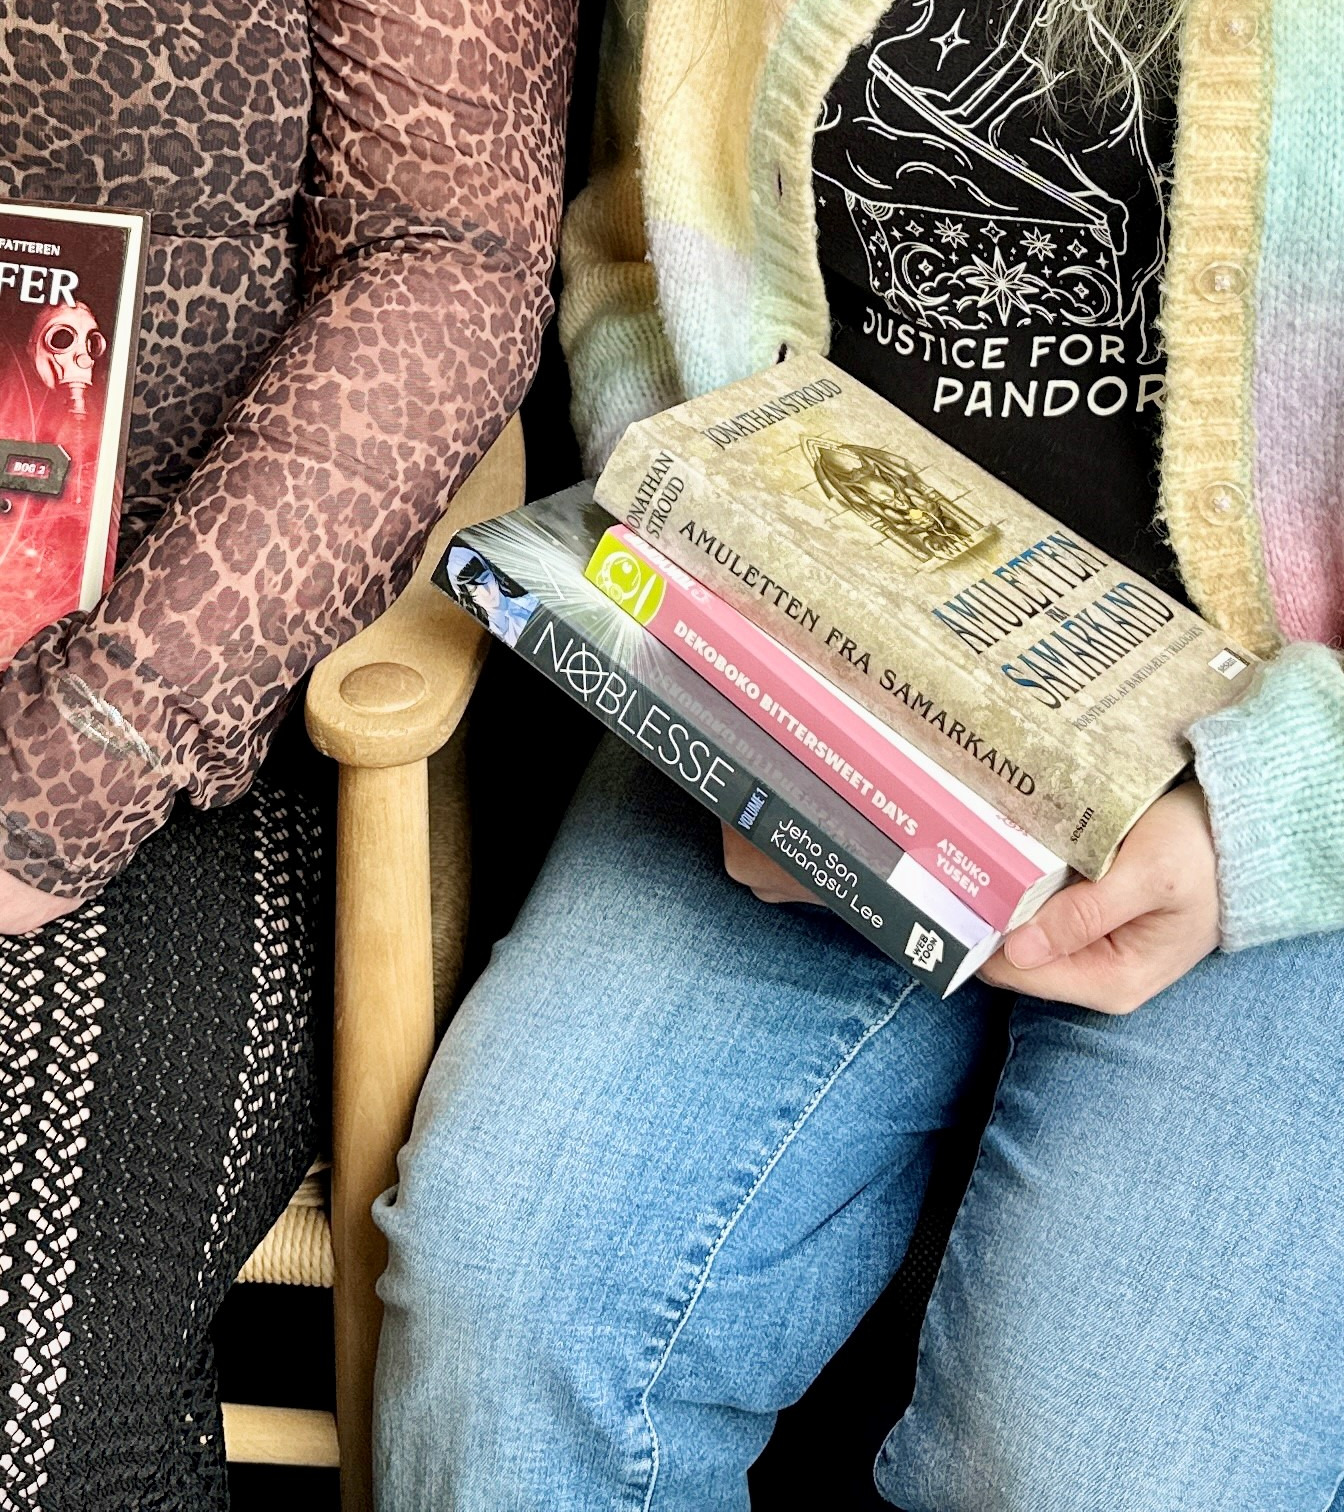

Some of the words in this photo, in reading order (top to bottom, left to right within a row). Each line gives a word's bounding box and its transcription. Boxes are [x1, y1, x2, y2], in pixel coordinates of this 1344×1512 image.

[863, 306, 1010, 370] JUSTICE
[1029, 334, 1126, 367] FOR
[700, 400, 790, 450] JONATHAN
[778, 378, 843, 415] STROUD
[13, 461, 36, 474] BOG
[37, 465, 46, 475] 2
[626, 448, 674, 530] ONATHAN
[646, 476, 685, 539] STROUD
[931, 530, 1109, 655] AMULETTEN
[679, 519, 821, 633] AMULETTEN
[824, 626, 872, 675] FRA
[879, 668, 1036, 797] SAMARKAND
[1001, 581, 1175, 710] SAMARKAND
[673, 619, 760, 700] DEKOBOKO
[758, 693, 878, 796] BITTERSWEET
[870, 787, 919, 837] DAYS
[738, 792, 765, 830] VOLUME
[1069, 806, 1095, 845] sesam
[769, 829, 849, 900] Kwangsu
[849, 893, 884, 929] Lee
[778, 819, 823, 858] Jeho
[825, 851, 858, 888] Son
[935, 853, 980, 899] YUSEN
[936, 838, 991, 887] ATSUKO
[913, 933, 928, 957] WEB
[918, 936, 938, 965] TOON
